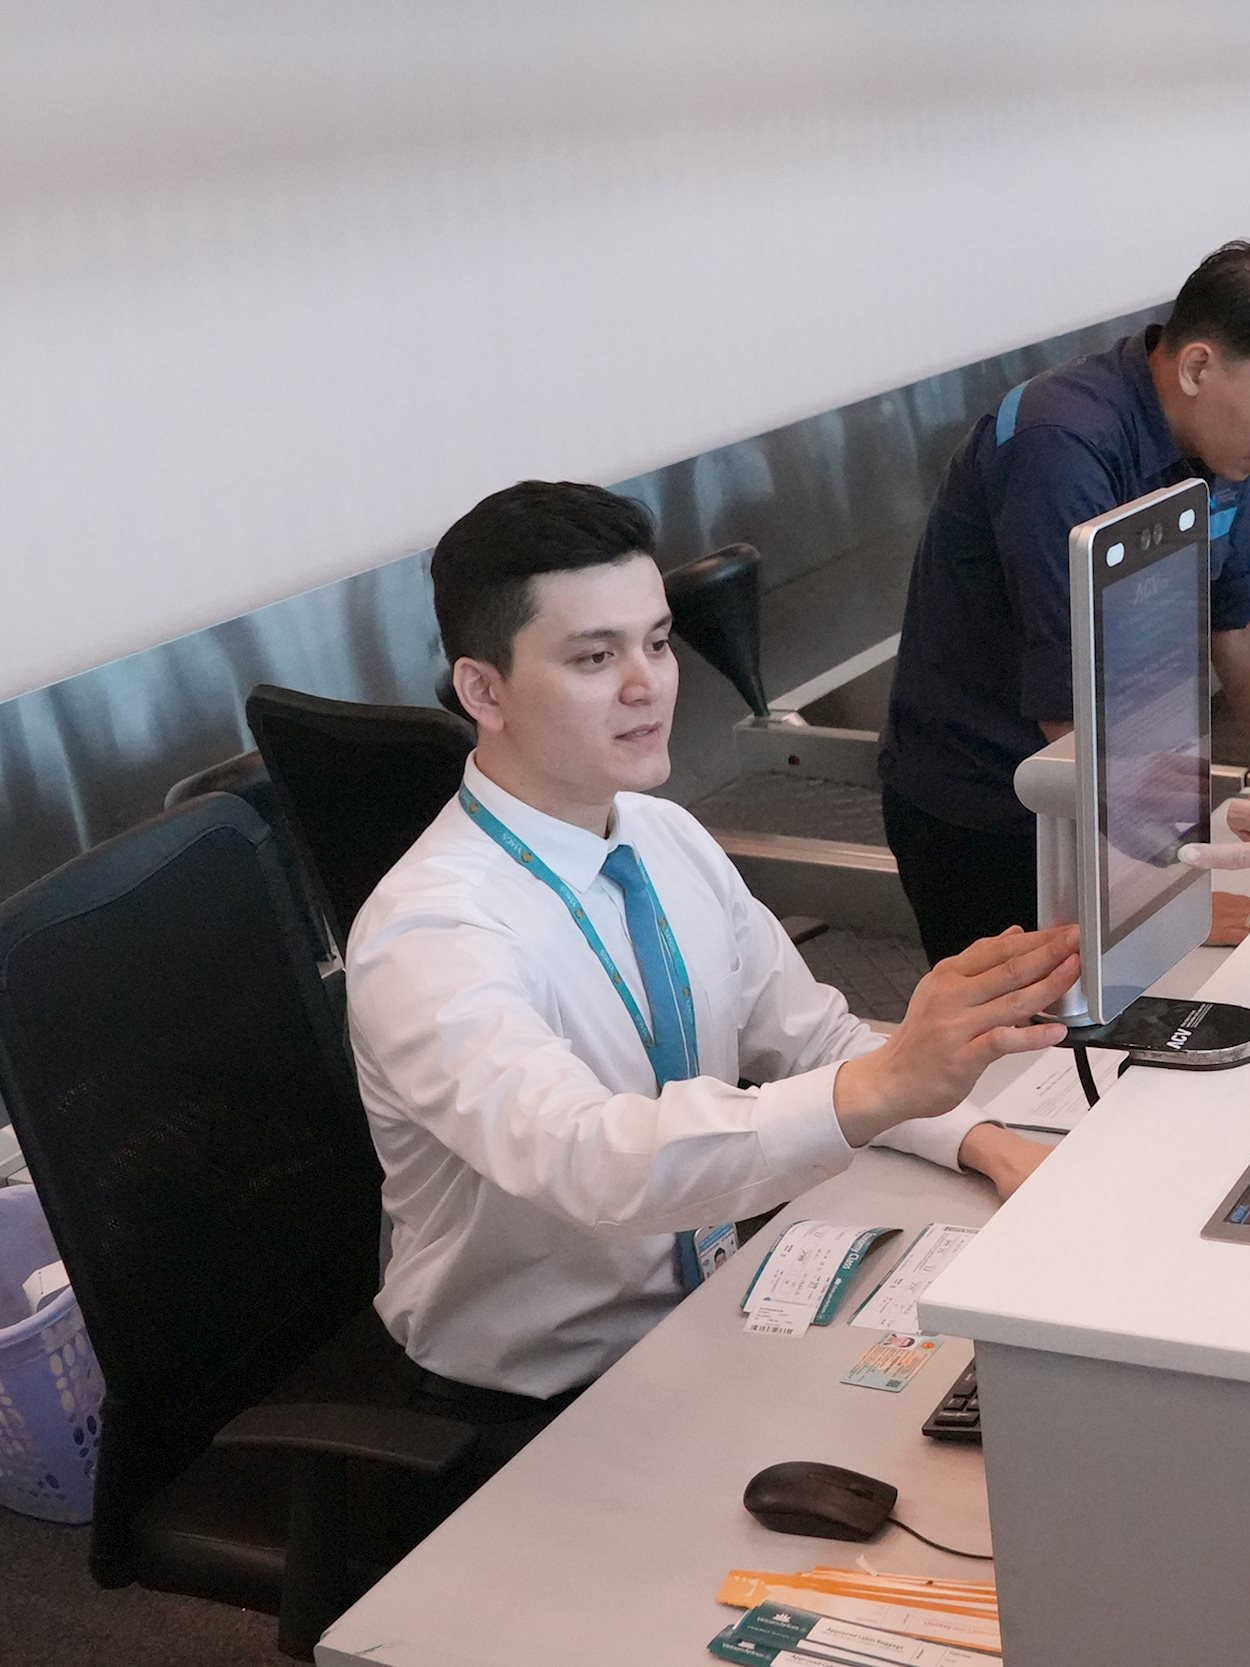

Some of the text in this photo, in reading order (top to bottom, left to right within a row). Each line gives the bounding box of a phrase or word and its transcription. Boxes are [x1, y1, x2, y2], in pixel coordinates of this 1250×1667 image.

[502, 832, 522, 855] VIAGS
[1166, 1027, 1192, 1050] ACV
[842, 1253, 859, 1270] Class
